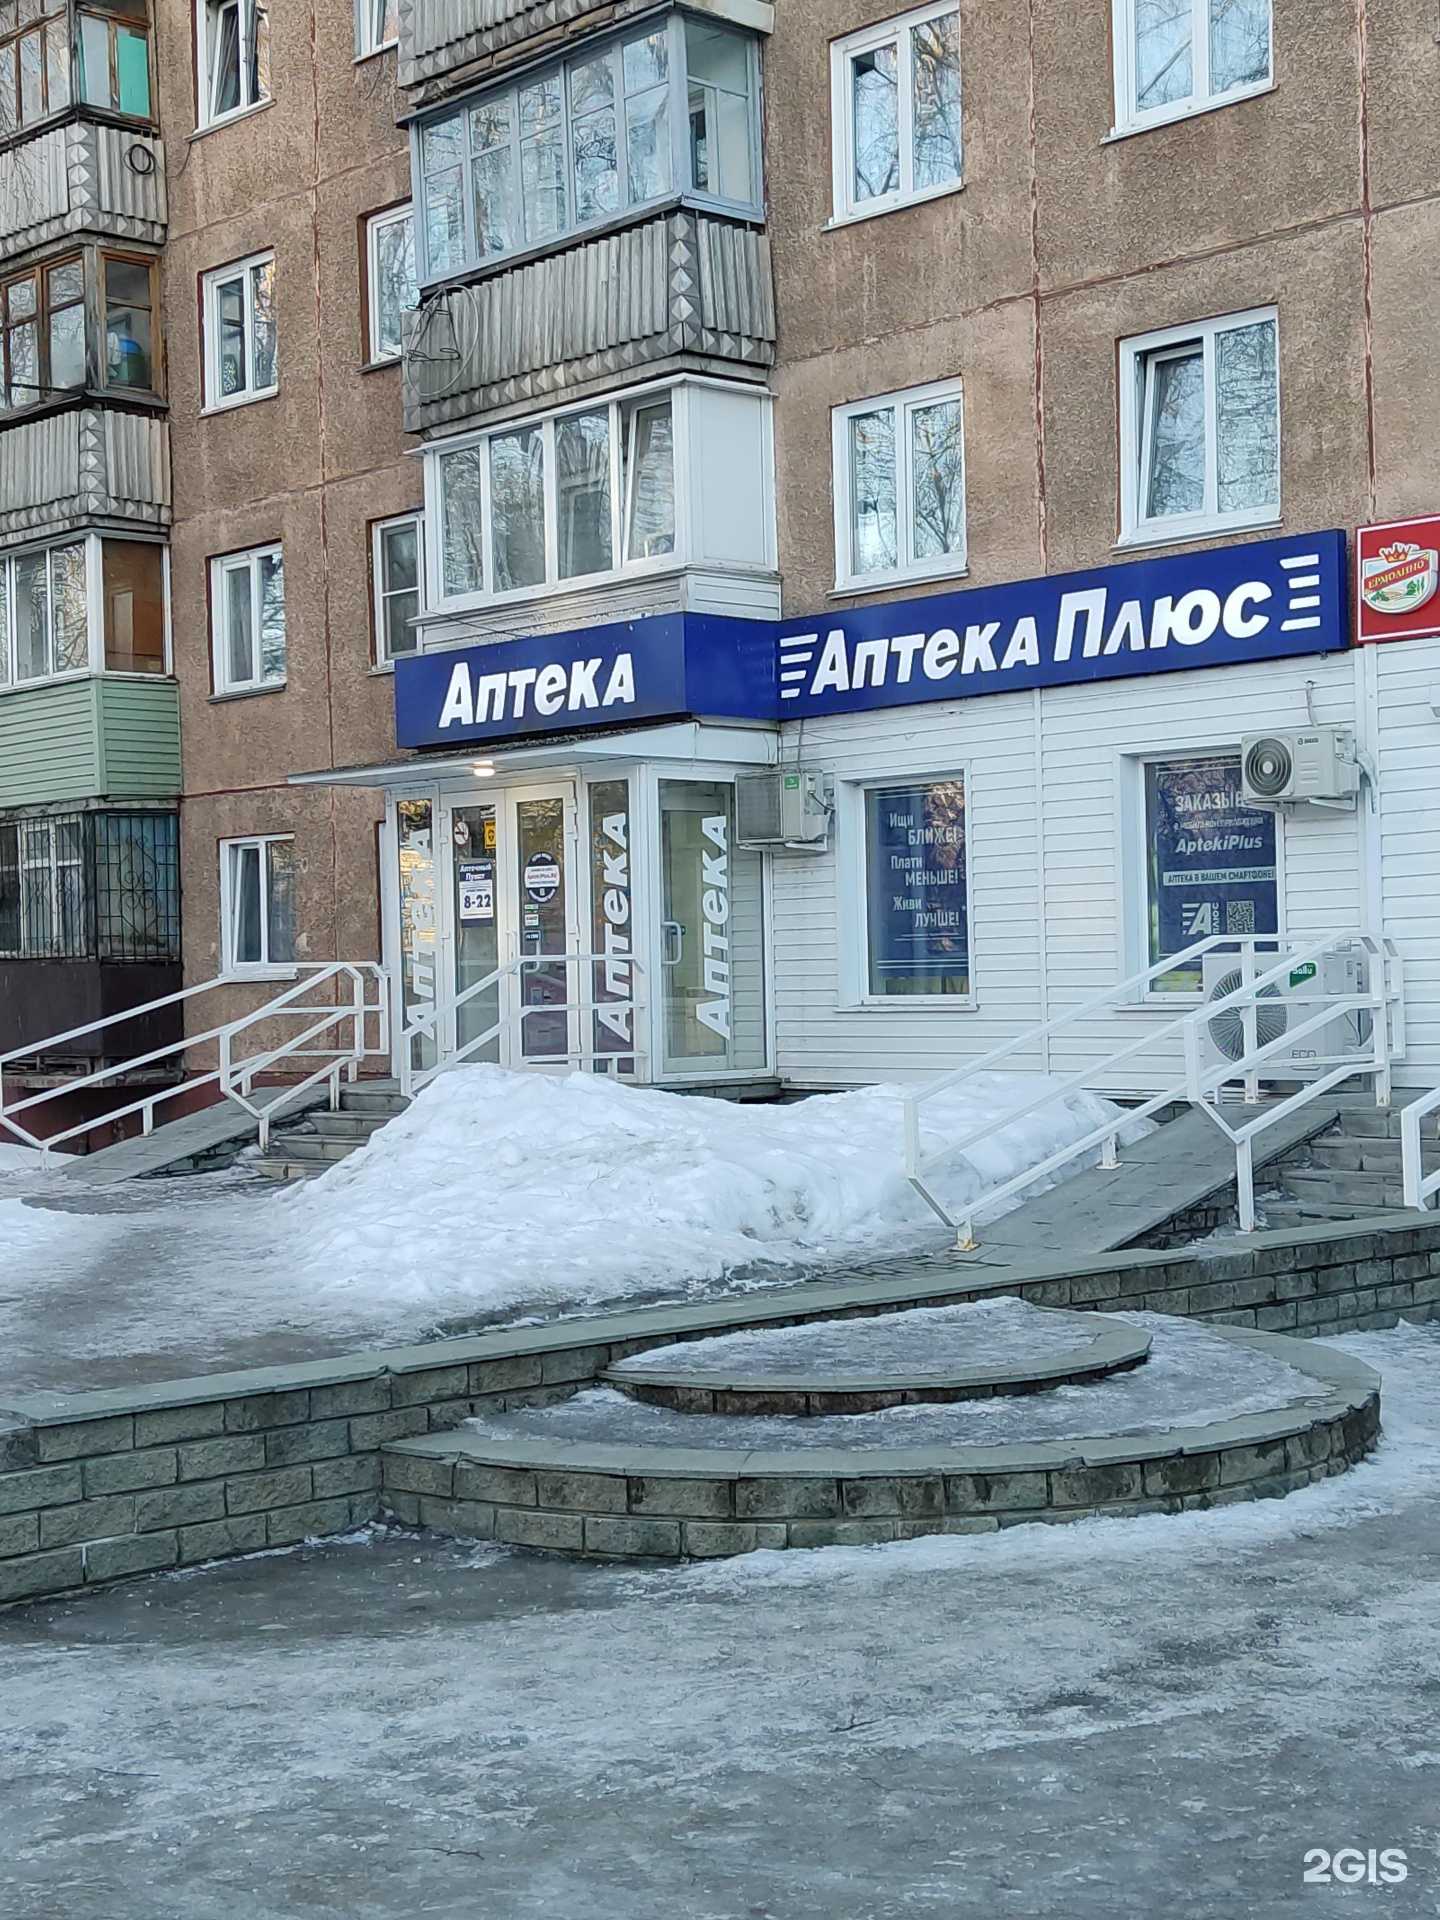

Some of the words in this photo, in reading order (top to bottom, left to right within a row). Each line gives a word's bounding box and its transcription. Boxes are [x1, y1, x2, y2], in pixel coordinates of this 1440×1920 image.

[1367, 559, 1424, 589] ЕРМОЛИНО
[1053, 581, 1273, 662] Плюс
[890, 813, 914, 828] Ищи
[908, 826, 957, 845] БЛИЖЕ!
[1175, 835, 1263, 855] AptekiPlus
[891, 855, 923, 869] Плати
[905, 868, 958, 886] МЕНЬШЕ!
[1168, 873, 1194, 883] АПТЕКА
[464, 894, 491, 908] 8-22
[893, 896, 922, 911] Живи
[915, 911, 959, 928] ЛУЧШЕ!
